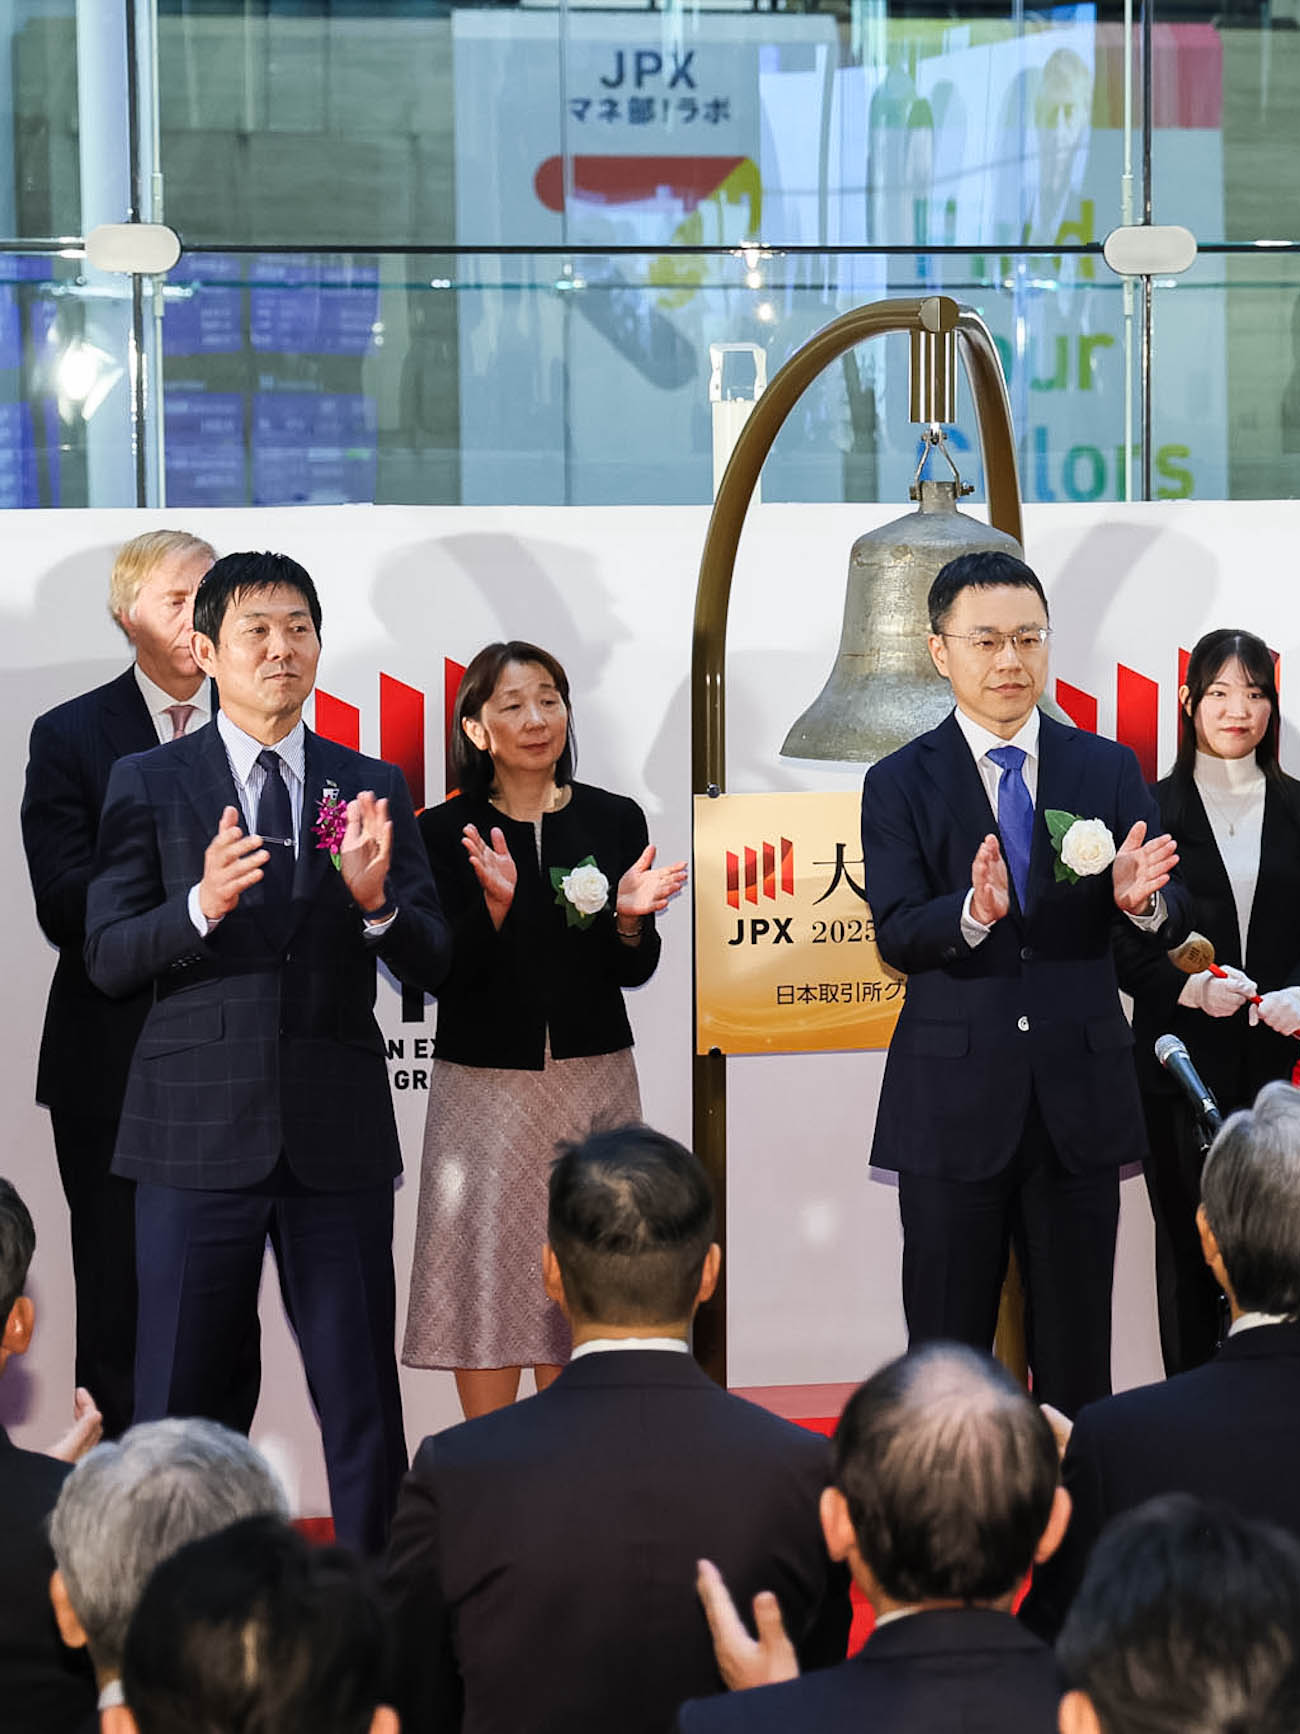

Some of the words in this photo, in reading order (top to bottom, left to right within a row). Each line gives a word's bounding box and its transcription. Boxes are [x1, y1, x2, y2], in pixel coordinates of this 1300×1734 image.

[601, 50, 697, 88] JPX
[916, 426, 1196, 500] Clors
[728, 917, 794, 945] JPX
[812, 919, 877, 943] 2025
[777, 978, 907, 1004] 日本取引所グ
